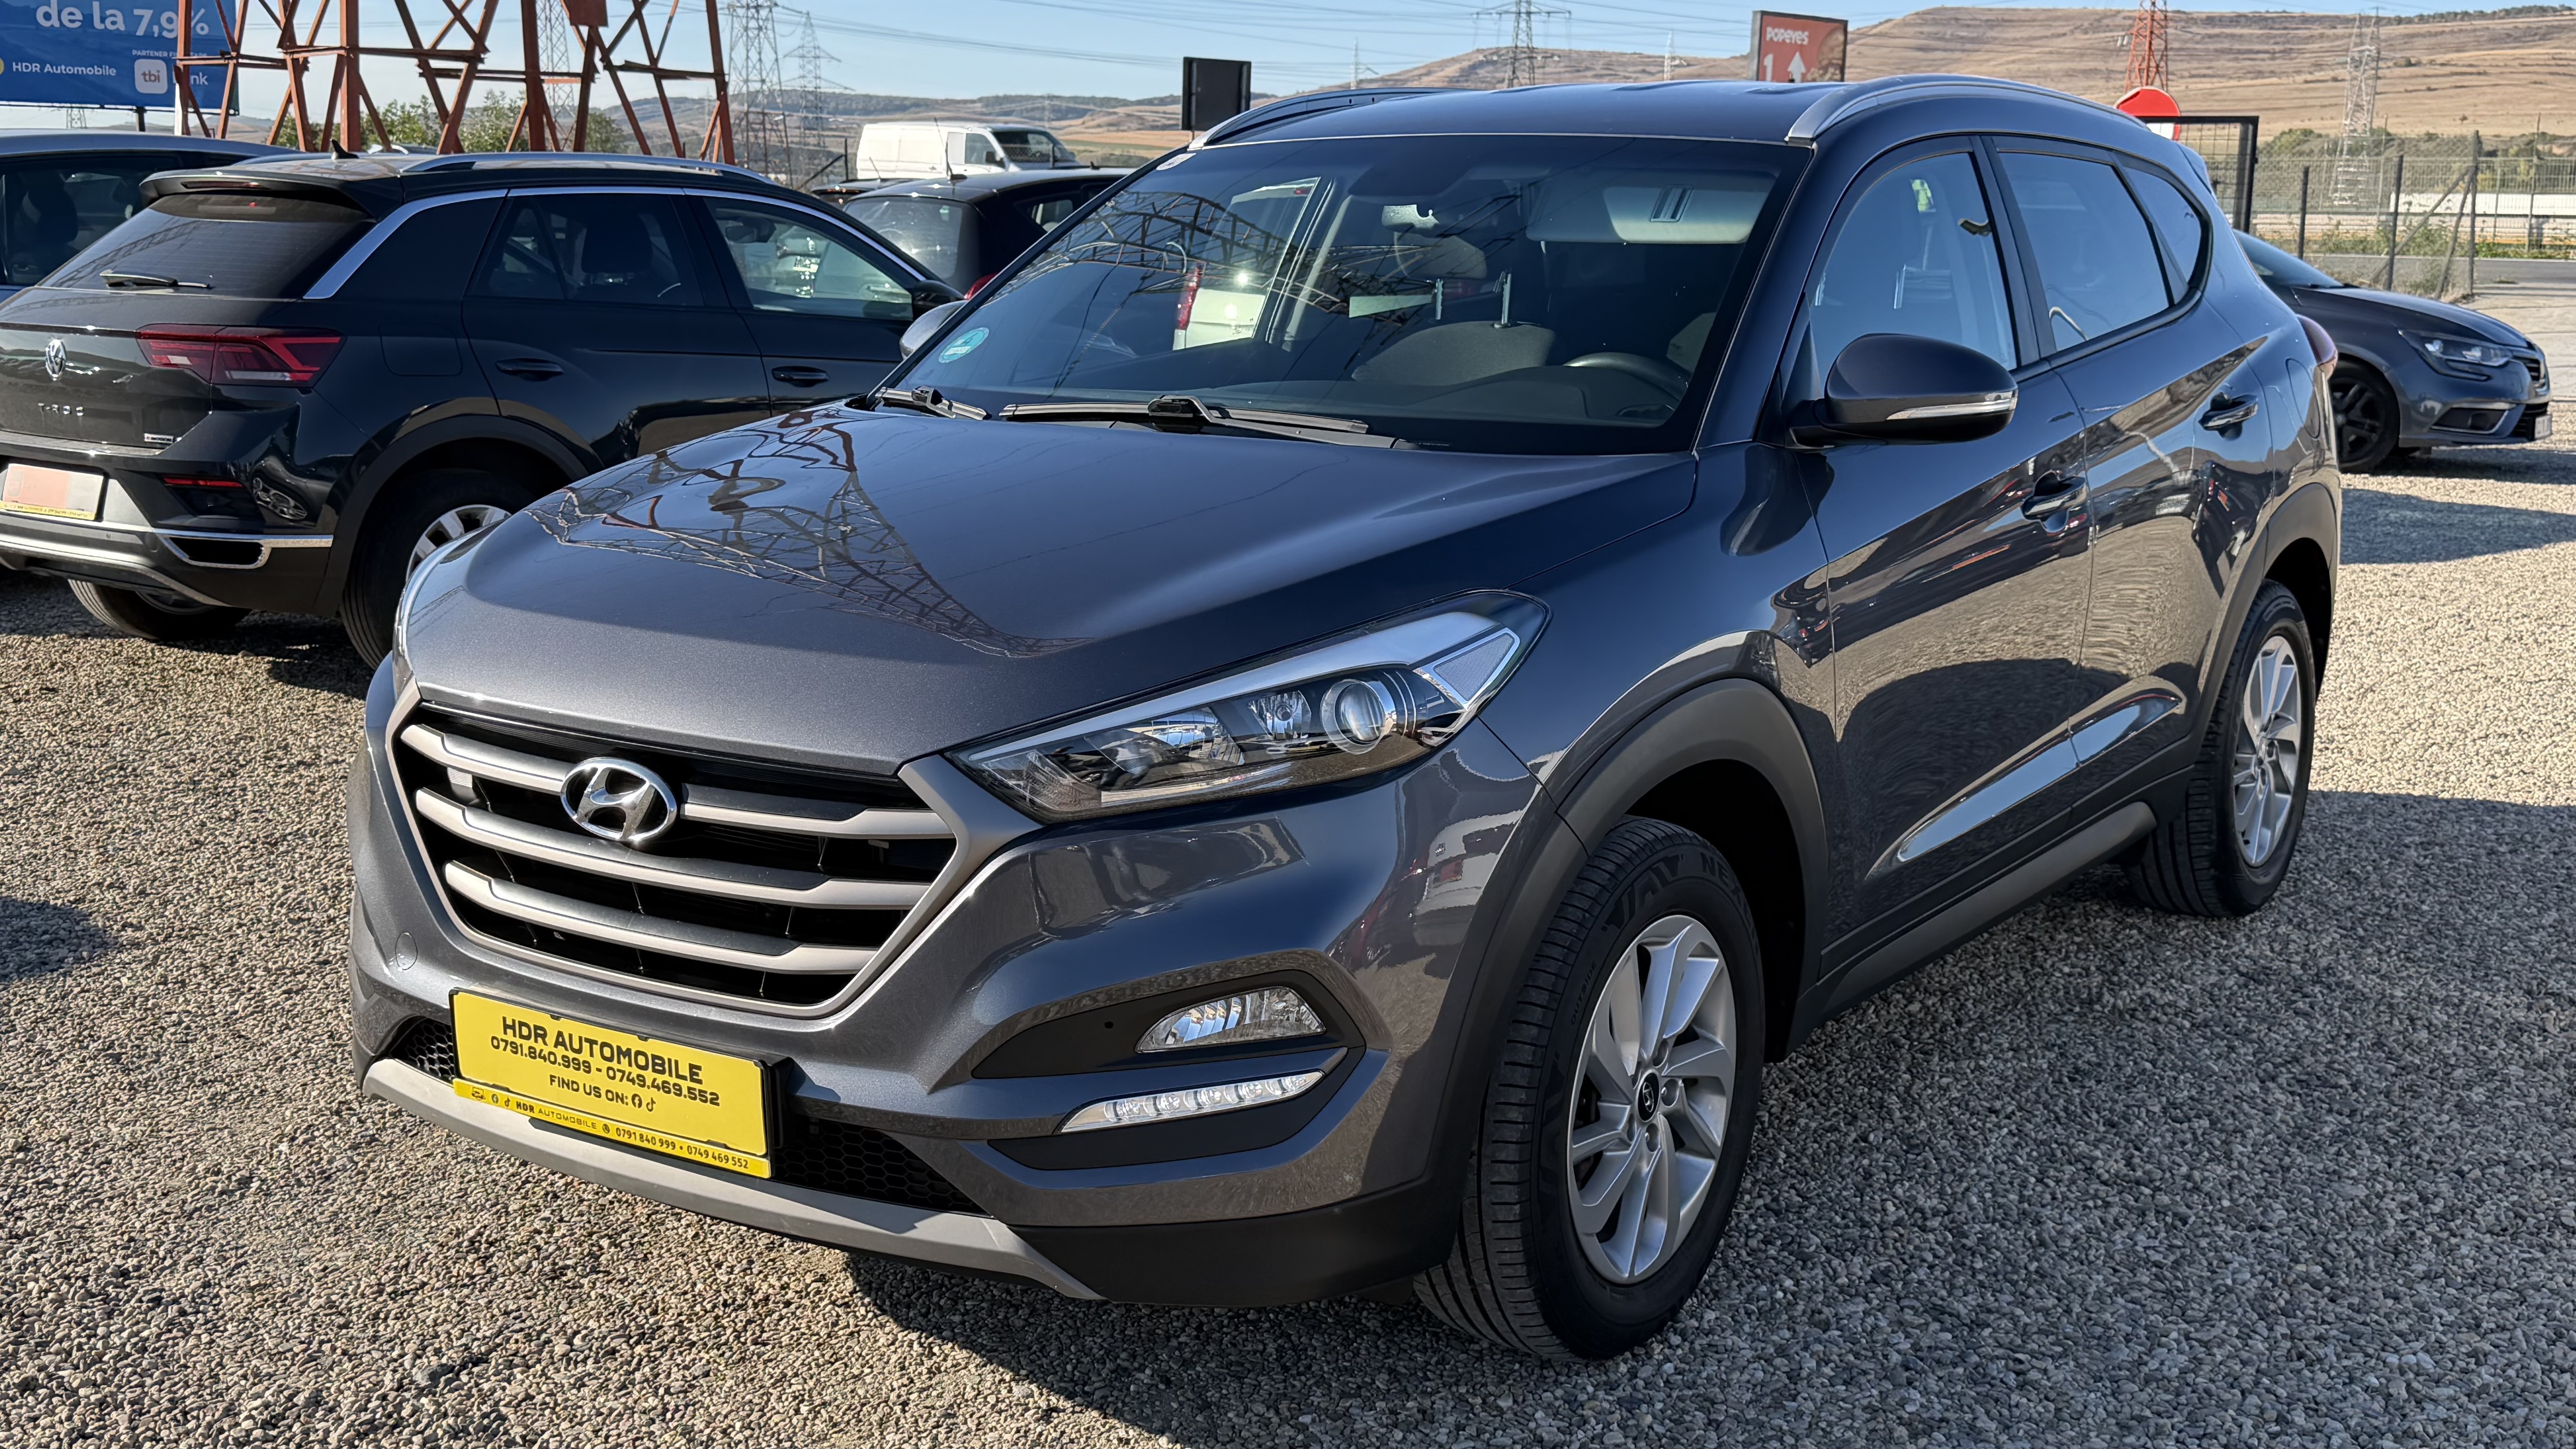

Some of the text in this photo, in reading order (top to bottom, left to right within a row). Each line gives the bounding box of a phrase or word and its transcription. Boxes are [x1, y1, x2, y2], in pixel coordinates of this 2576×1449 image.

[36, 0, 209, 39] de la 7,9%
[1766, 26, 1809, 45] POPEYES
[13, 62, 116, 76] HDR Automobile
[141, 69, 161, 83] tbi
[1571, 959, 1597, 1026] OUTSIDE
[502, 1016, 703, 1085] HDR AUTOMOBILE
[491, 1035, 592, 1074] 0791.840.999
[606, 1066, 720, 1107] 0749.469.552
[549, 1074, 629, 1106] FIND US ON:
[516, 1100, 749, 1169] HDR AUTOMOBILE 0791 840 999 0749 469 552
